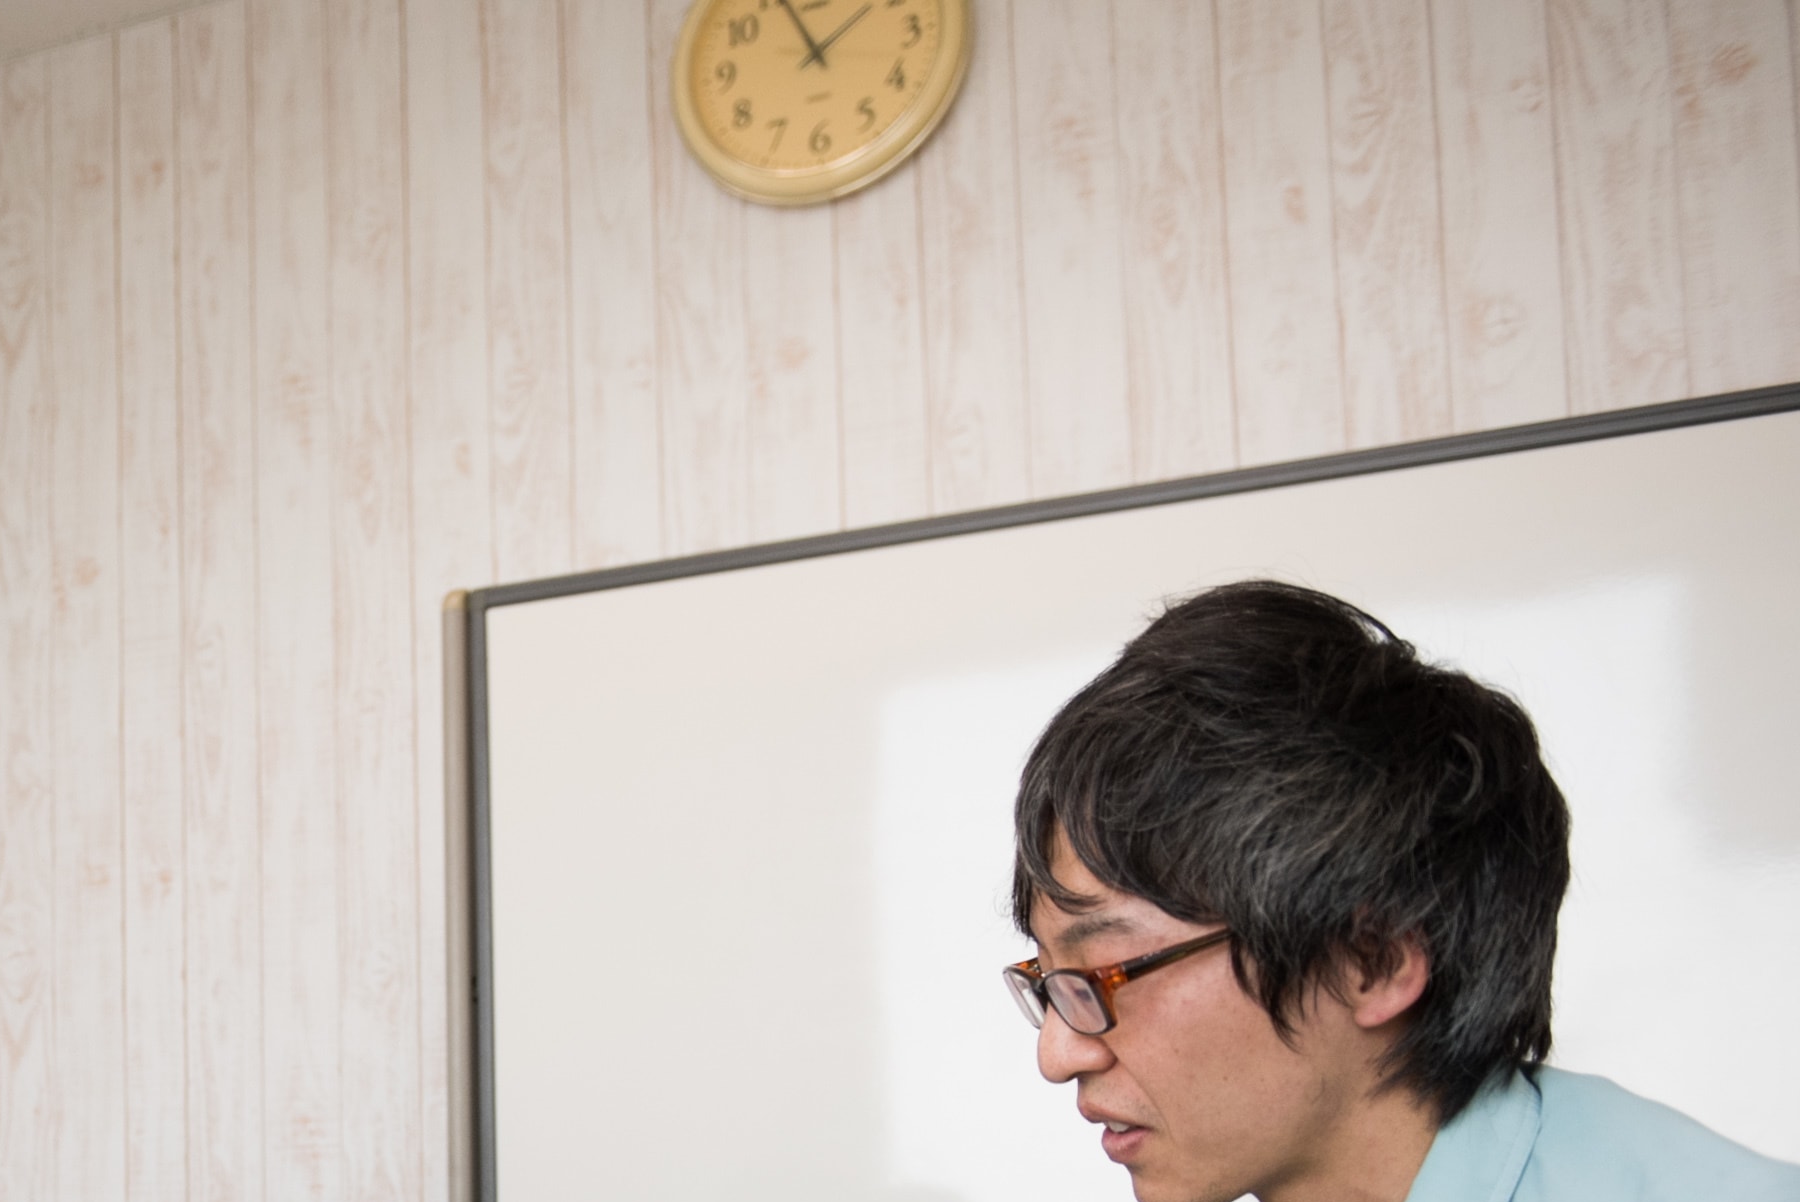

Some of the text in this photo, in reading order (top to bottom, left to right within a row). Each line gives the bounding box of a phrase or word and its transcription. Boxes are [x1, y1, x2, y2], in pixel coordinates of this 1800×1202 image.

[727, 13, 760, 47] 10
[902, 12, 922, 49] 3
[714, 60, 737, 94] 9
[883, 57, 906, 92] 4
[732, 98, 753, 131] 8
[855, 96, 876, 133] 5
[765, 117, 789, 155] 7
[808, 119, 833, 155] 6
